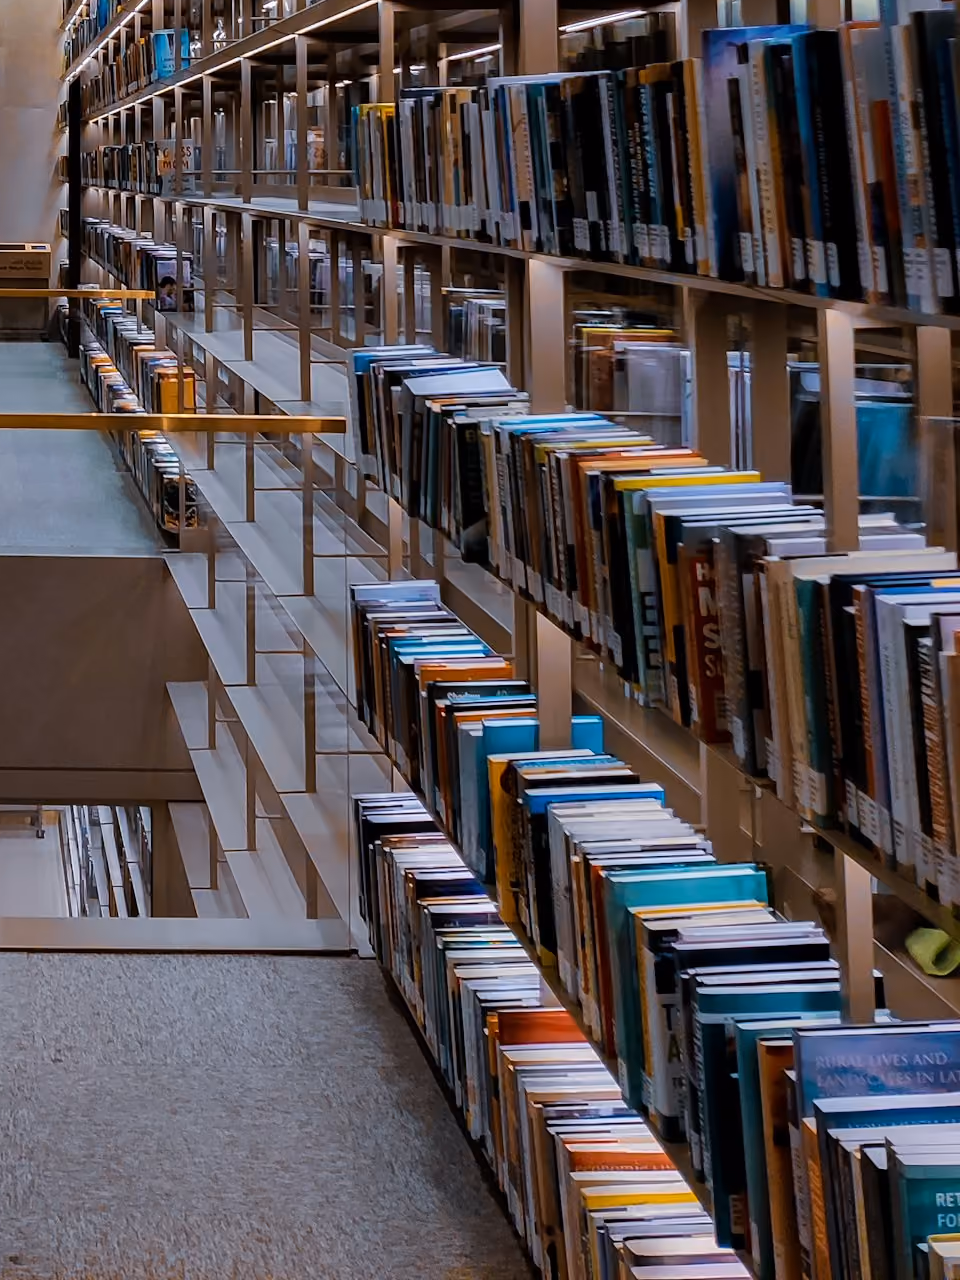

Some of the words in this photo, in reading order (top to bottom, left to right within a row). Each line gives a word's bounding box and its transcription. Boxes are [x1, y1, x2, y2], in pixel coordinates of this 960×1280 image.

[867, 1052, 908, 1067] LIVES
[913, 1051, 948, 1066] AND
[916, 1071, 934, 1084] IN
[937, 1213, 960, 1228] FO
